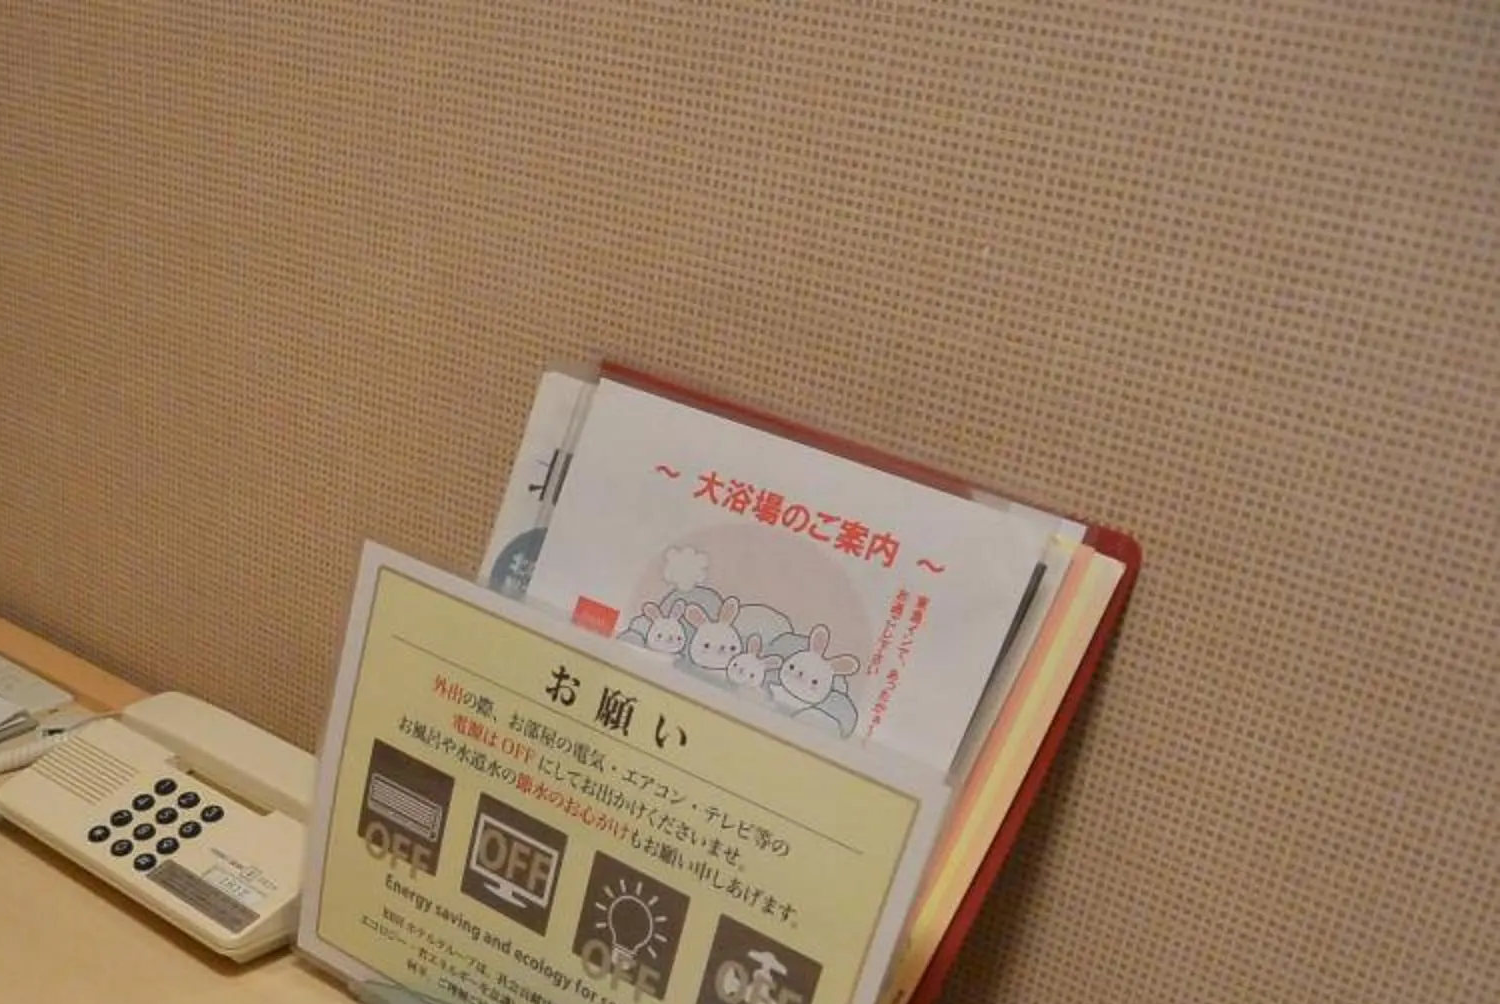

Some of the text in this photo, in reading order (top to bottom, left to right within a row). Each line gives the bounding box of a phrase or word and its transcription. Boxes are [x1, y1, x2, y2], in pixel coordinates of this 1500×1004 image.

[693, 471, 901, 568] 大浴場のご案内
[361, 816, 433, 887] OFF
[476, 825, 555, 899] OFF
[384, 875, 433, 912] Energy
[432, 902, 483, 943] saving
[482, 929, 513, 954] and
[513, 946, 573, 992] ecology
[574, 978, 598, 1004] for
